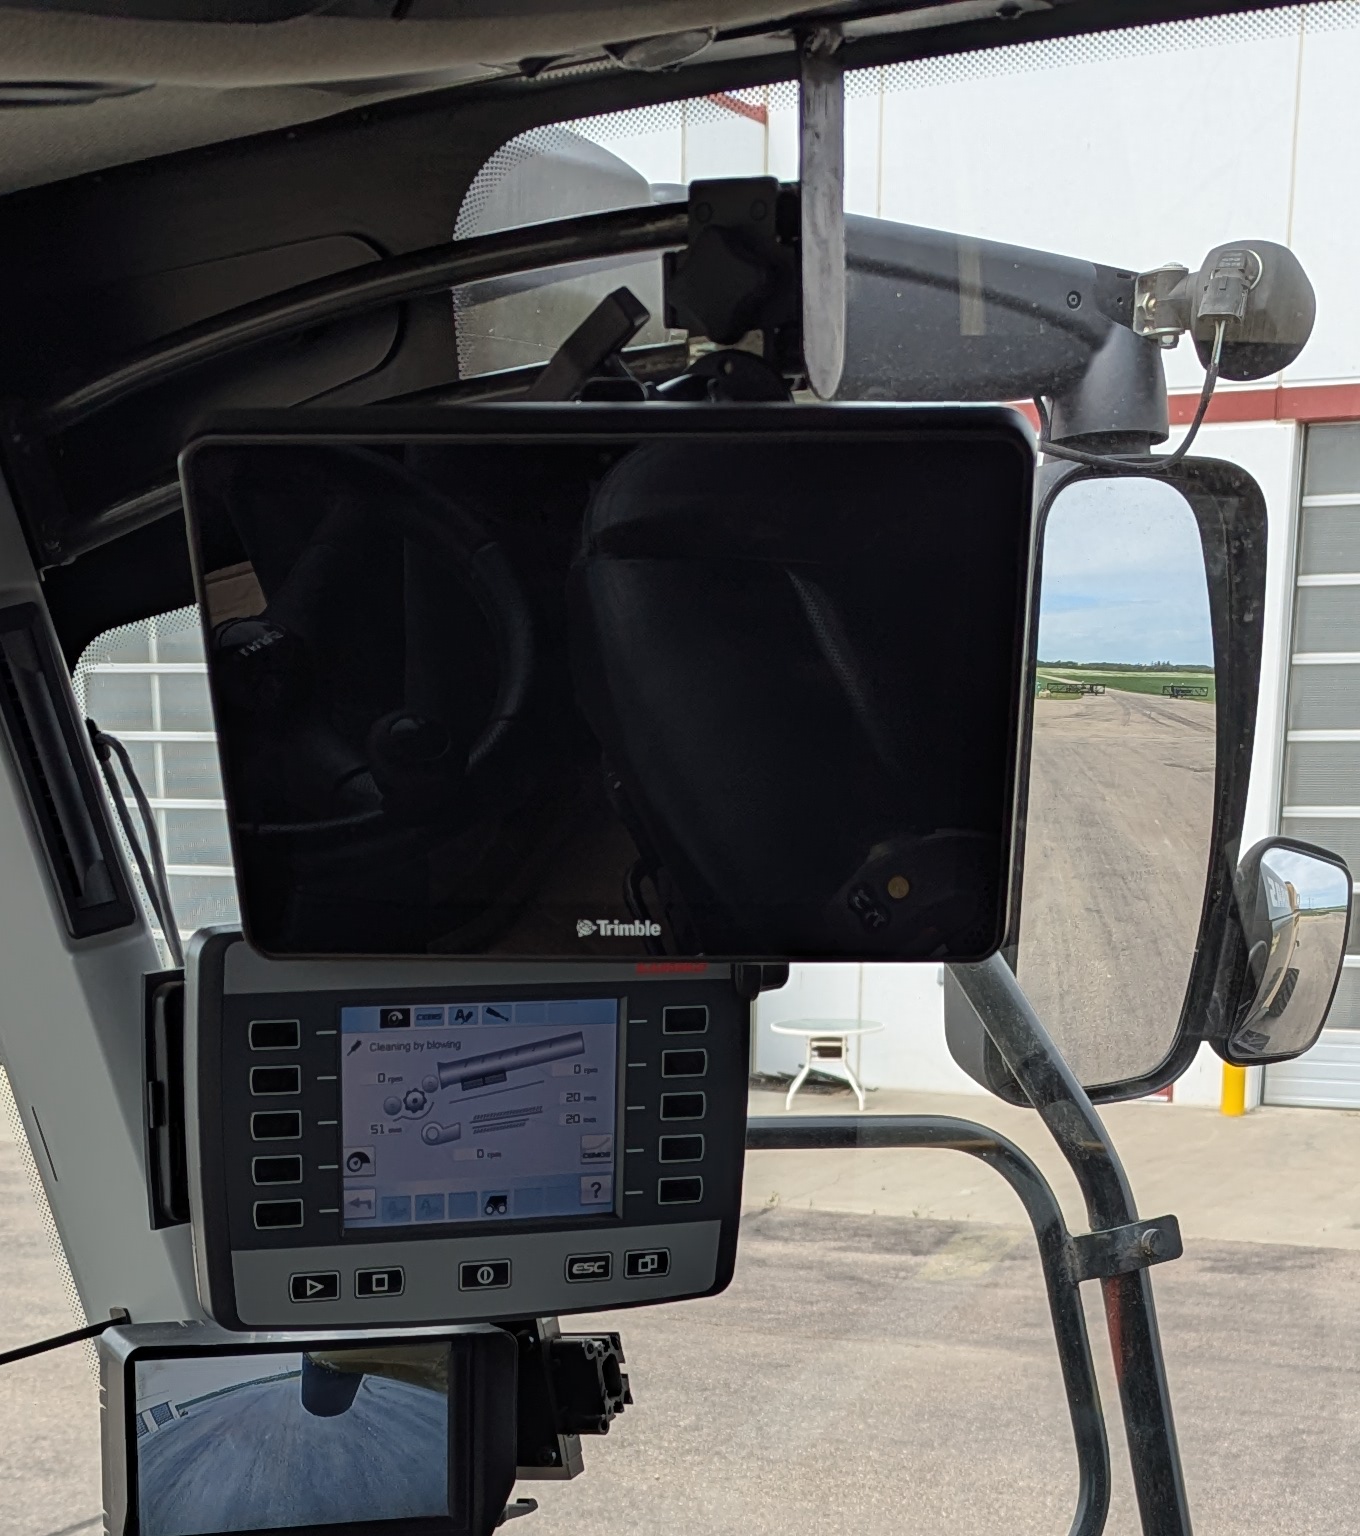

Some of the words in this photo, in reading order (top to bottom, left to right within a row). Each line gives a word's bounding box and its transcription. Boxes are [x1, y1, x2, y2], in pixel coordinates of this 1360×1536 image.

[596, 919, 661, 937] Trimble
[370, 1041, 411, 1053] Cleaning
[413, 1041, 425, 1052] by
[426, 1039, 462, 1051] blowing
[573, 1064, 581, 1074] 0
[377, 1073, 386, 1083] 0
[566, 1092, 581, 1103] 20
[565, 1113, 581, 1124] 20
[370, 1124, 385, 1135] 51
[476, 1149, 484, 1158] 0
[572, 1261, 606, 1274] ESC
